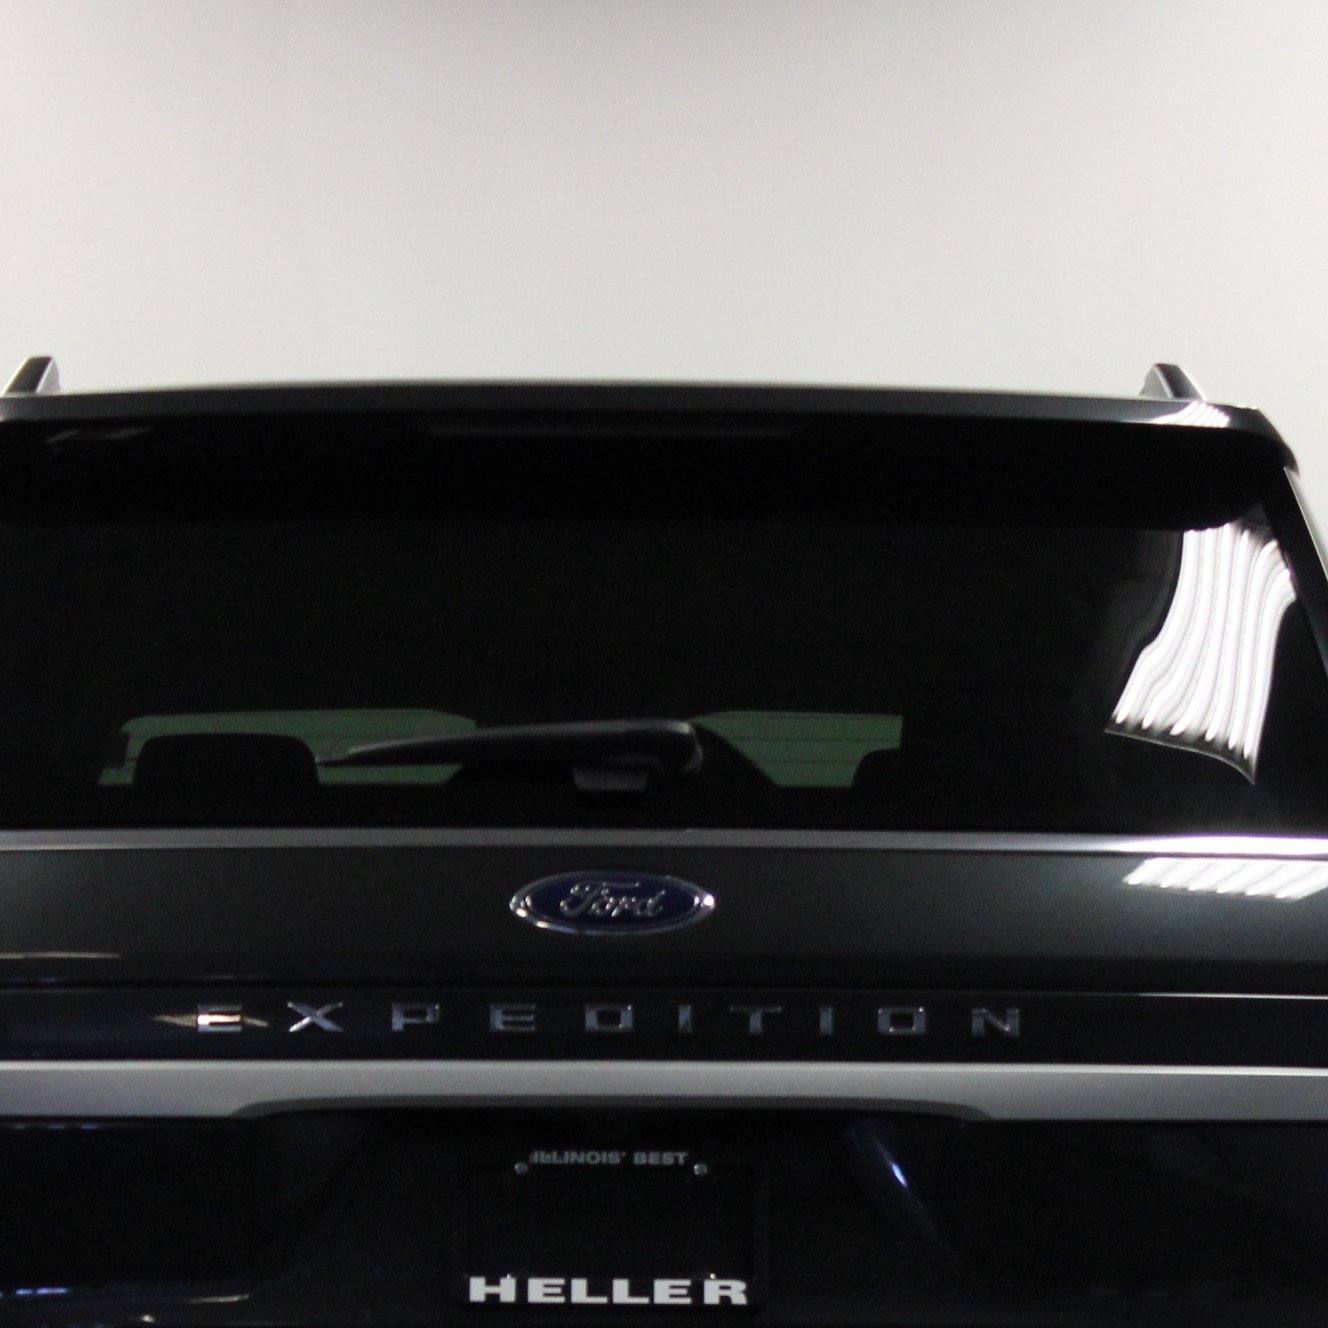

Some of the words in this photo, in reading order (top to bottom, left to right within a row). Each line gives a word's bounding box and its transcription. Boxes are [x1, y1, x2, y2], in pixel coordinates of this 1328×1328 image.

[560, 881, 665, 917] Ford
[197, 1002, 1020, 1037] EXPEDITION
[632, 1151, 688, 1165] BEST
[469, 1275, 748, 1305] HELLER
